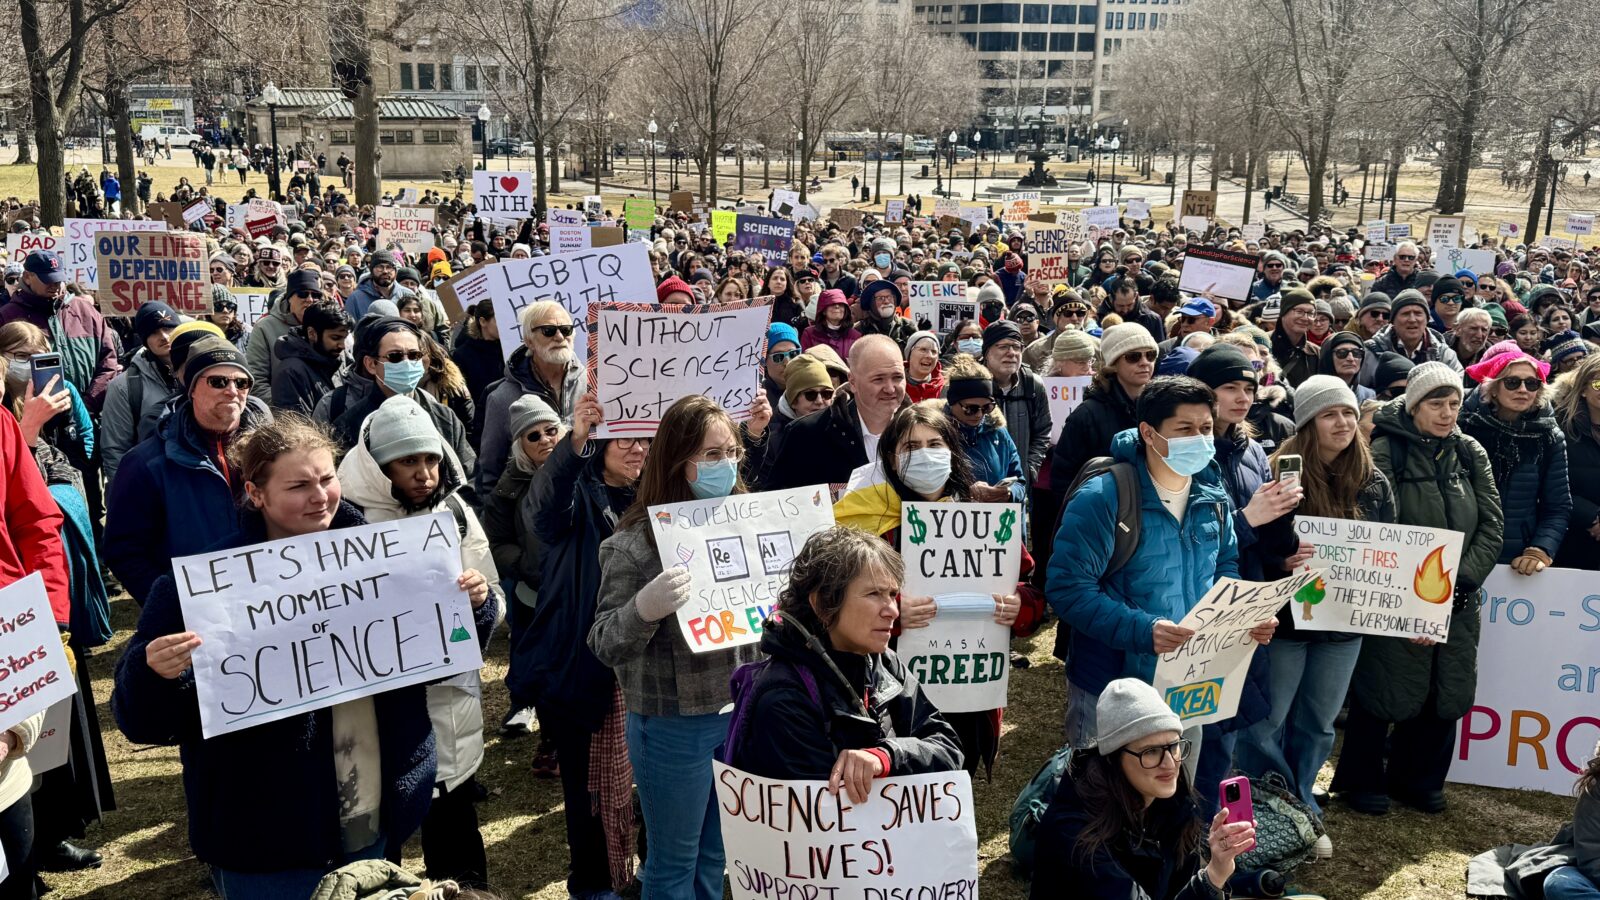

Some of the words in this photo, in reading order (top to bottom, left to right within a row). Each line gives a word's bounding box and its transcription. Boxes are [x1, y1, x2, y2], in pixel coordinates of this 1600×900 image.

[489, 176, 498, 193] I
[480, 195, 528, 212] NIH
[1002, 193, 1020, 201] LESS
[1022, 192, 1038, 200] FEAR
[1186, 193, 1211, 202] Free
[1062, 213, 1080, 222] THIS
[1186, 203, 1215, 216] NIH
[377, 217, 435, 232] REJECTED
[743, 222, 791, 238] SCIENCE
[1035, 229, 1065, 241] FUND
[1060, 221, 1082, 233] MUSK
[21, 235, 56, 249] BAD
[98, 236, 142, 256] OUR
[149, 236, 201, 258] LIVES
[1028, 240, 1068, 254] SCIENCE
[70, 243, 87, 264] IS
[1041, 256, 1062, 267] NOT
[1188, 247, 1256, 264] #StandUpForScience
[502, 254, 624, 291] LGBTQ
[1029, 267, 1069, 280] FASCISM
[111, 280, 207, 312] SCIENCE
[910, 284, 966, 297] SCIENCE
[940, 304, 975, 312] SCIENCE
[604, 315, 736, 346] WITHOUT
[678, 501, 762, 530] SCIENCE
[778, 496, 800, 518] IS
[1298, 520, 1337, 536] ONLY
[1379, 527, 1401, 542] CAN
[1405, 531, 1435, 547] STOP
[182, 545, 303, 597] LET'S
[315, 529, 407, 572] HAVE
[422, 519, 452, 551] A
[712, 547, 731, 565] Re
[920, 544, 1006, 578] CAN'T
[1311, 544, 1357, 562] FOREST
[1362, 548, 1399, 569] FIRES.
[247, 573, 389, 630] MOMENT
[699, 581, 779, 613] SCIENCE
[1211, 581, 1272, 606] I'VE
[1333, 586, 1367, 606] THEY
[1371, 591, 1403, 609] FIRED
[0, 608, 36, 637] ives
[312, 619, 331, 634] OF
[688, 610, 748, 646] FOR
[1350, 610, 1411, 632] EVERYONE
[929, 638, 986, 649] MASK
[908, 652, 1005, 684] GREED
[1184, 660, 1212, 681] AT
[0, 670, 59, 713] Science
[1169, 685, 1217, 716] IKEA
[720, 769, 857, 832] SCIENCE
[880, 781, 961, 831] SAVES
[784, 838, 894, 880] LIVES!
